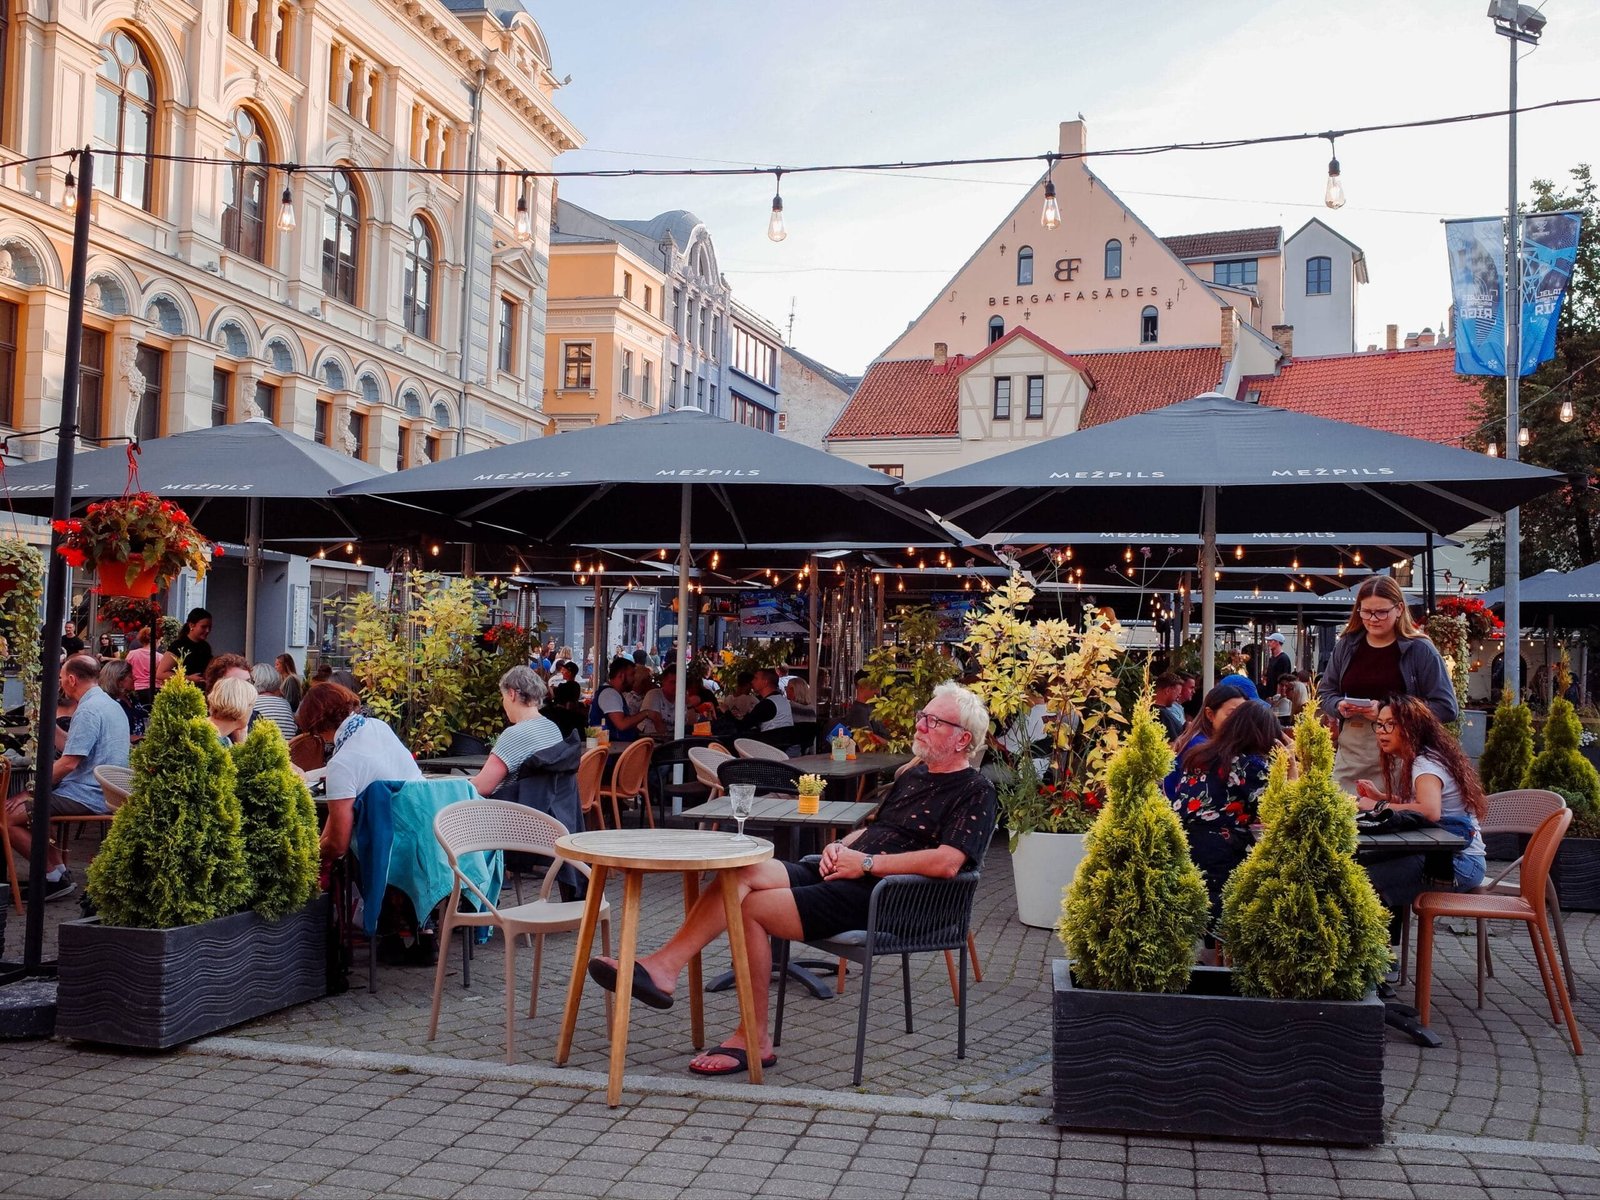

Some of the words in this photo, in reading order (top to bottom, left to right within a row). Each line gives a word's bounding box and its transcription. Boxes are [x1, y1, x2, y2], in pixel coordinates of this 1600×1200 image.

[988, 293, 1054, 306] BERGA
[1063, 286, 1158, 302] FASĀDES
[473, 471, 571, 481] MEŽPILS
[656, 468, 760, 476] MEŽPILS
[1048, 470, 1165, 478] MEŽPILS
[1271, 467, 1394, 477] MEŽPILS
[0, 484, 88, 492] MEŽPS
[161, 483, 254, 491] MEŽPILS
